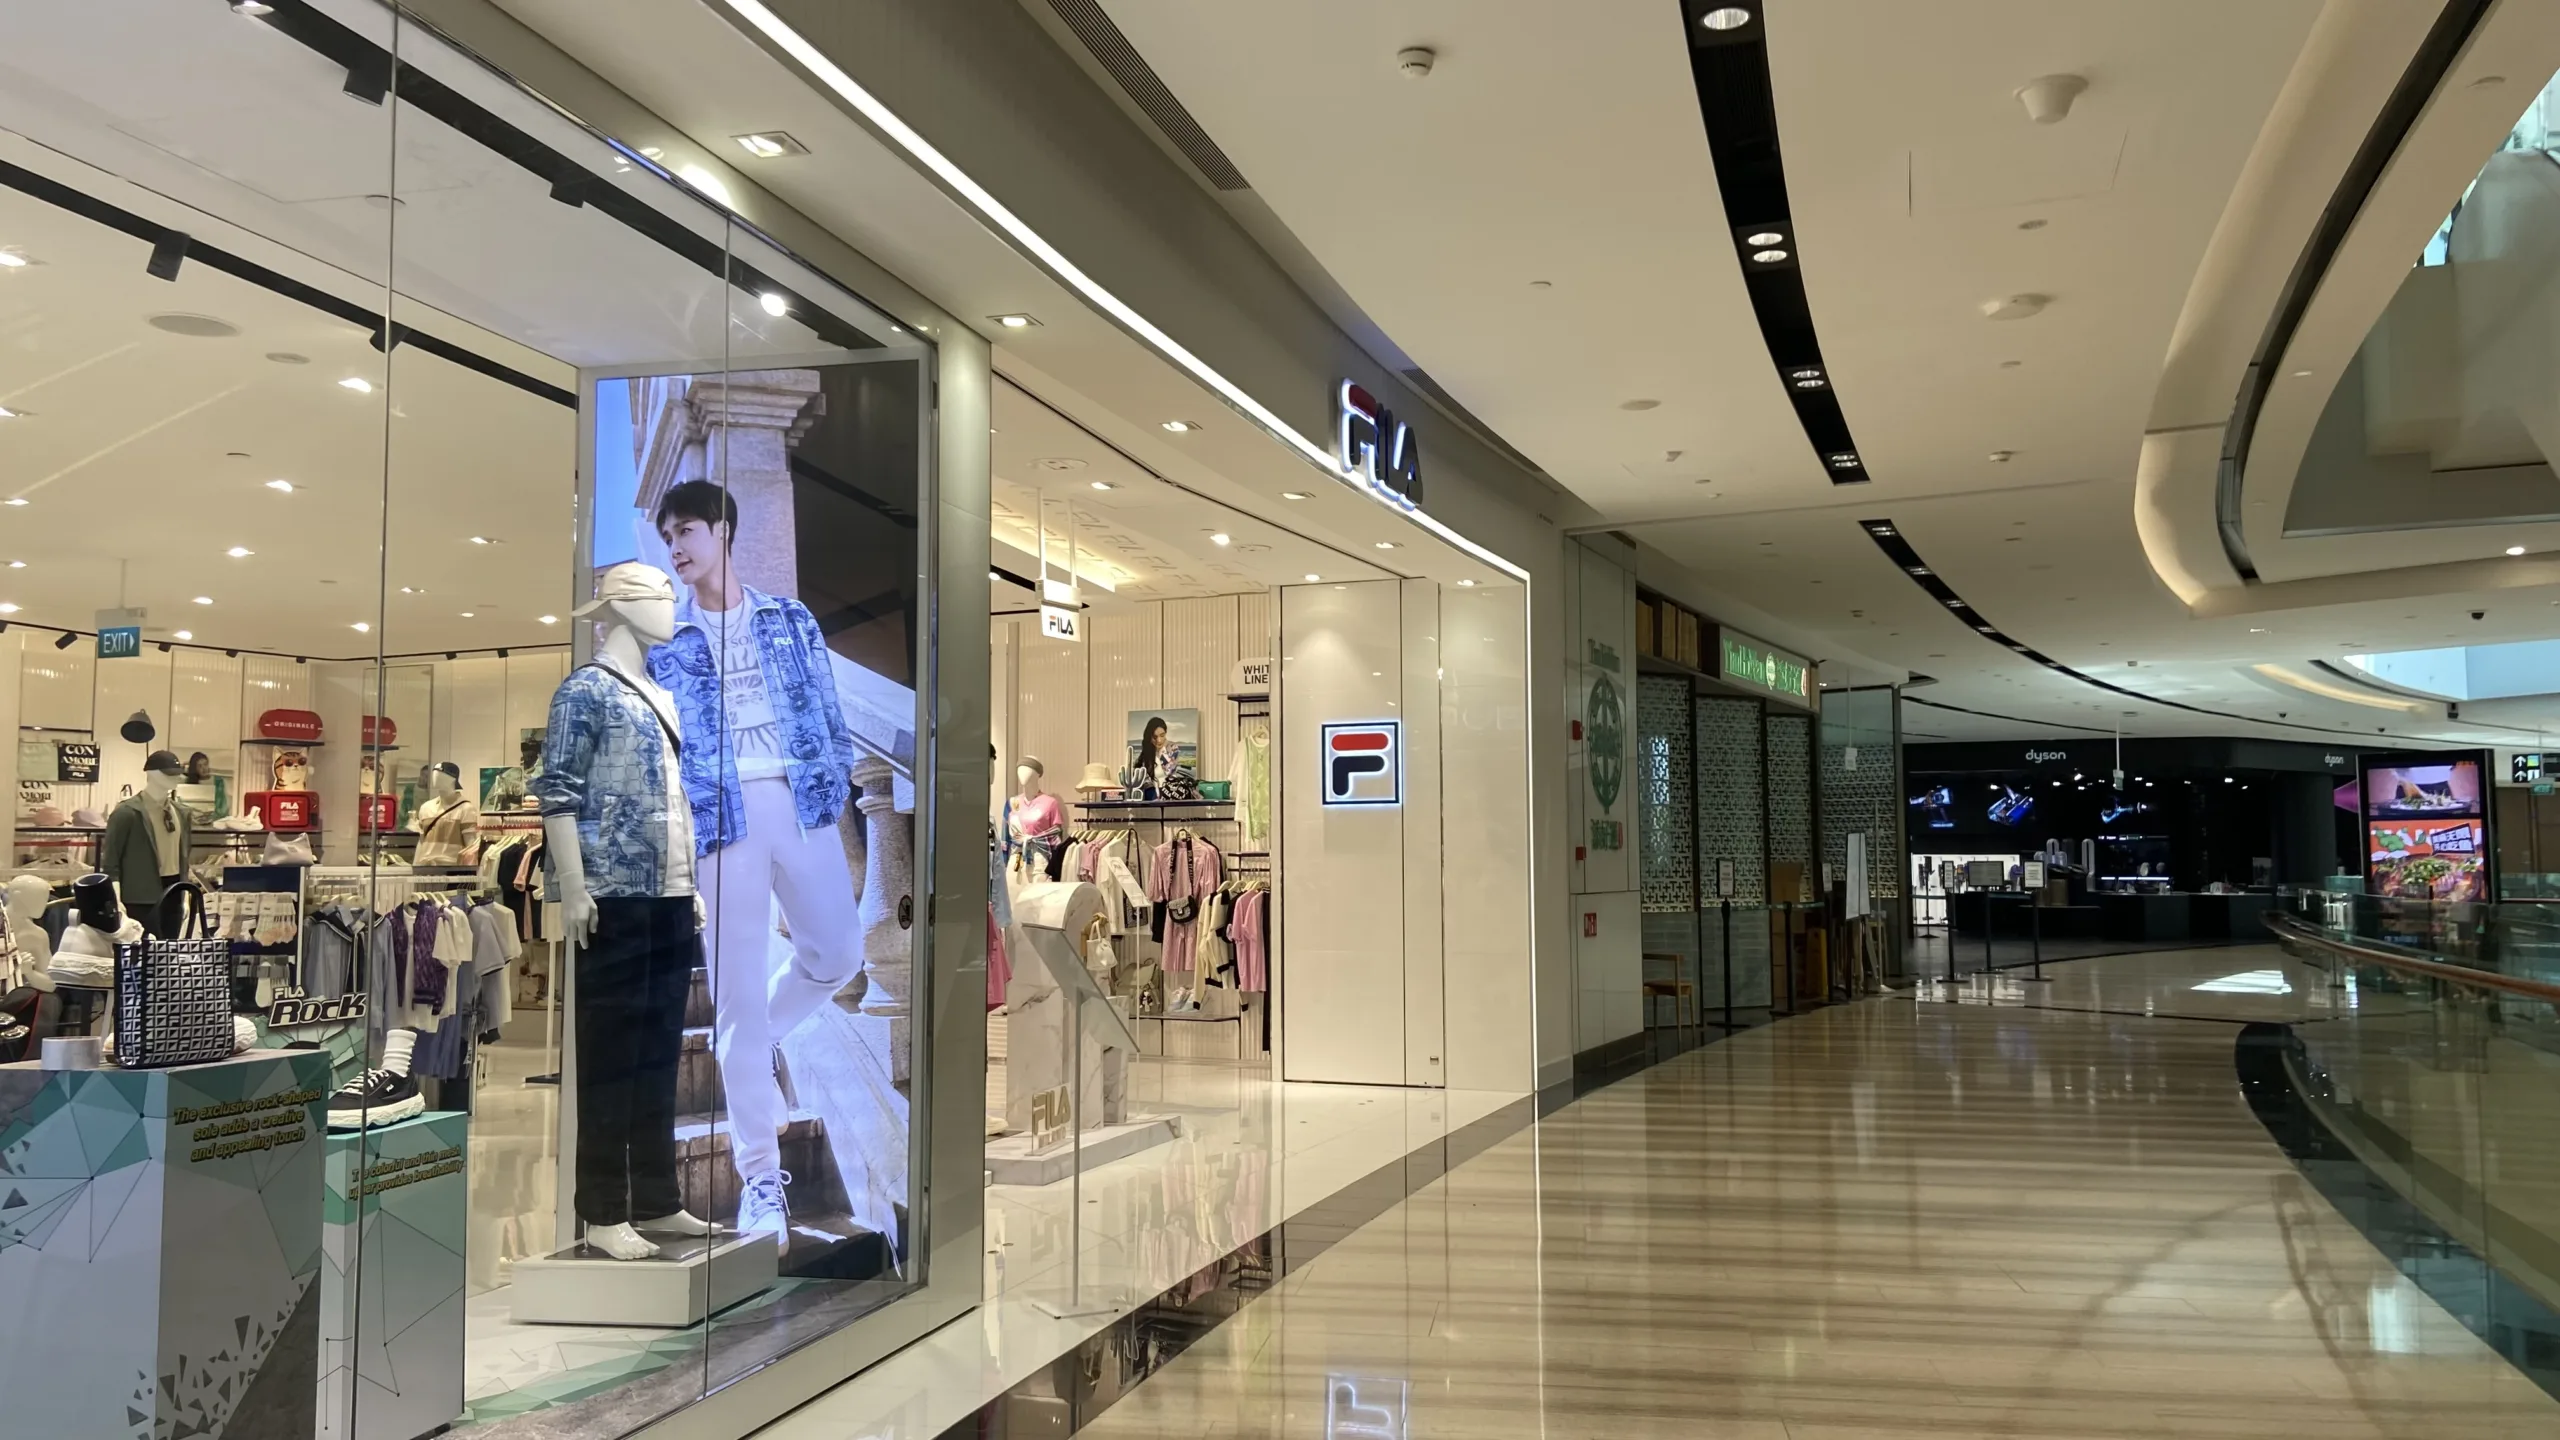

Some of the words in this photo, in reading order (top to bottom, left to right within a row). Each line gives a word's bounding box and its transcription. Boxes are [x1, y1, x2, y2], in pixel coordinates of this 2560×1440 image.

[1342, 377, 1424, 511] FILA
[1049, 615, 1074, 636] FILA
[103, 632, 128, 653] EXIT
[774, 636, 793, 646] FILA
[1244, 674, 1269, 684] LINE
[274, 721, 316, 730] ORIGINALE
[65, 745, 94, 755] CON
[2025, 748, 2067, 764] dyson
[280, 802, 299, 810] FILA
[274, 986, 305, 1000] FILA
[174, 1107, 198, 1125] The
[199, 1100, 252, 1120] exclusive
[253, 1086, 324, 1112] rock-shaped
[1031, 1085, 1071, 1136] FILA
[193, 1122, 219, 1141] sole
[220, 1117, 250, 1136] adds
[250, 1119, 260, 1131] a
[261, 1109, 305, 1129] creative
[190, 1146, 216, 1162] and
[216, 1133, 273, 1160] appealing
[273, 1126, 306, 1146] touch
[352, 1168, 370, 1182] Te
[370, 1157, 404, 1178] colorful
[404, 1154, 421, 1170] and
[420, 1150, 439, 1165] thin
[438, 1144, 462, 1160] mesh
[349, 1183, 376, 1200] uper
[375, 1173, 413, 1195] provides
[413, 1160, 465, 1183] breathability
